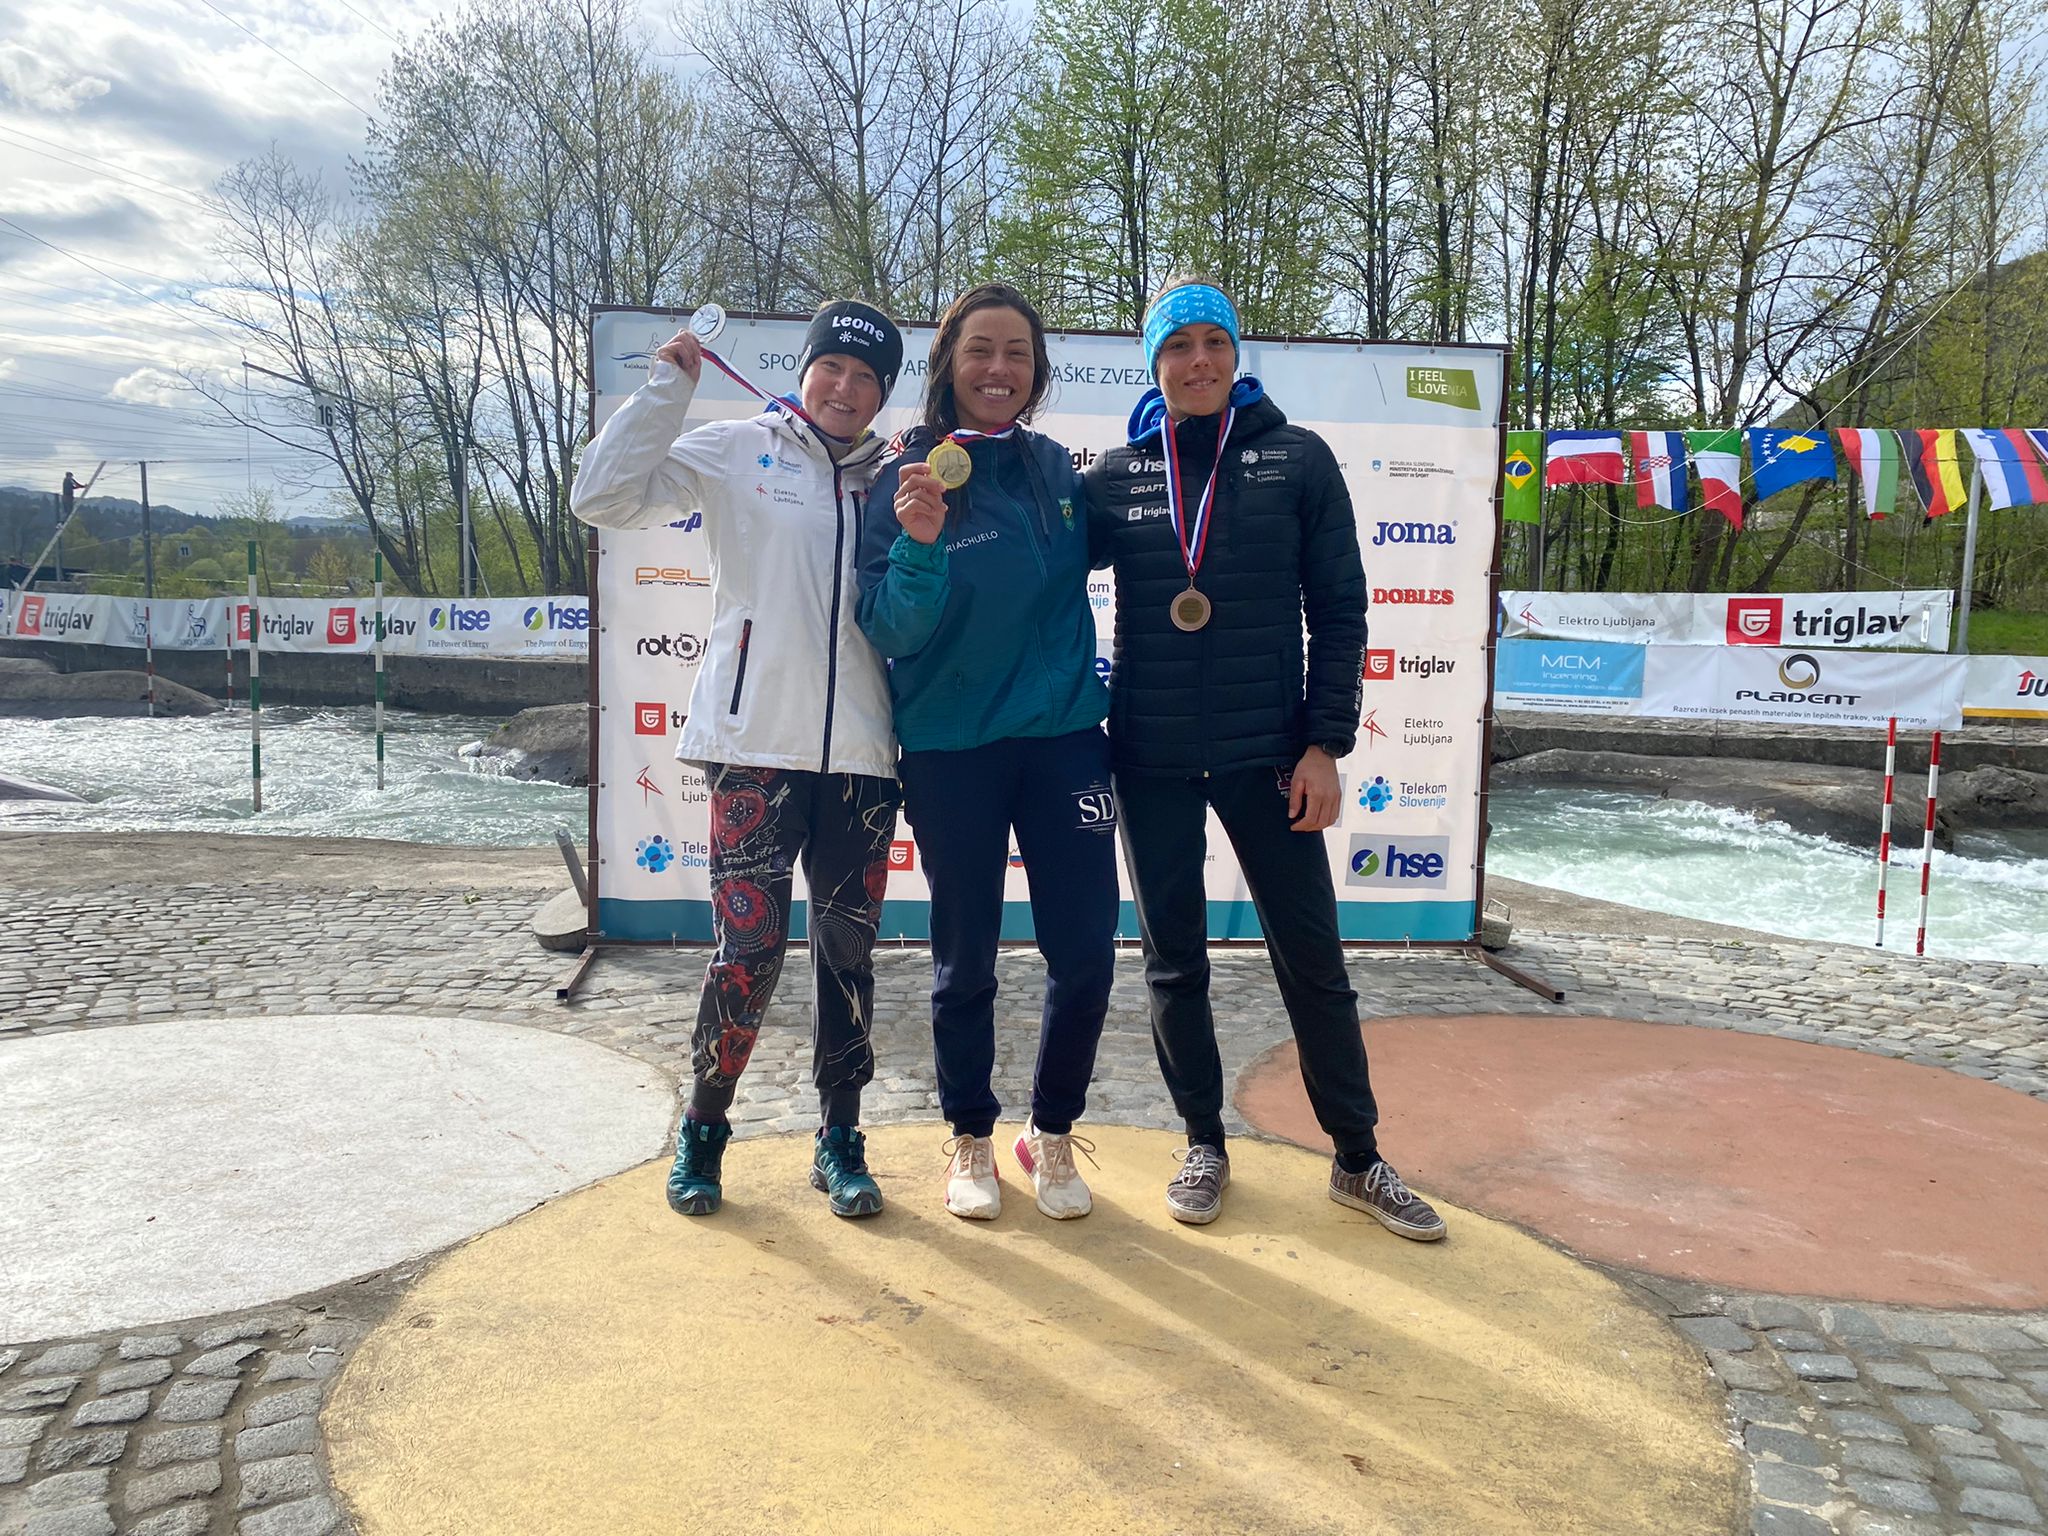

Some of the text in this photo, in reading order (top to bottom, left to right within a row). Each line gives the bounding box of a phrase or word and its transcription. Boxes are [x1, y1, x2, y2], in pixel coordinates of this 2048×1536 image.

[832, 315, 885, 342] Leone
[1409, 370, 1446, 382] I FEEL
[1410, 383, 1468, 397] SLOVENIA
[318, 404, 333, 427] 16
[1130, 484, 1165, 494] CRAFT
[945, 530, 998, 553] RIACHUELO
[1372, 588, 1455, 605] DOBLES
[44, 606, 94, 635] triglav
[450, 603, 490, 631] hse
[548, 602, 589, 630] hse
[1558, 616, 1656, 628] Elektro Ljubljana
[1793, 607, 1910, 643] triglav
[263, 614, 314, 641] triglav
[558, 639, 567, 648] of
[1399, 655, 1456, 678] triglav
[1673, 705, 1698, 713] Razrez
[1709, 706, 1727, 714] izsek
[1729, 708, 1760, 716] penastih
[1762, 710, 1801, 718] materialov
[1813, 712, 1841, 720] lepilnih
[1843, 713, 1870, 721] trakov,
[1405, 718, 1443, 729] Elektro
[1403, 733, 1453, 746] Ljubljana
[1400, 782, 1447, 794] Telekom
[1078, 793, 1114, 823] SD
[1399, 795, 1446, 809] Slovenije
[1386, 845, 1444, 878] hse
